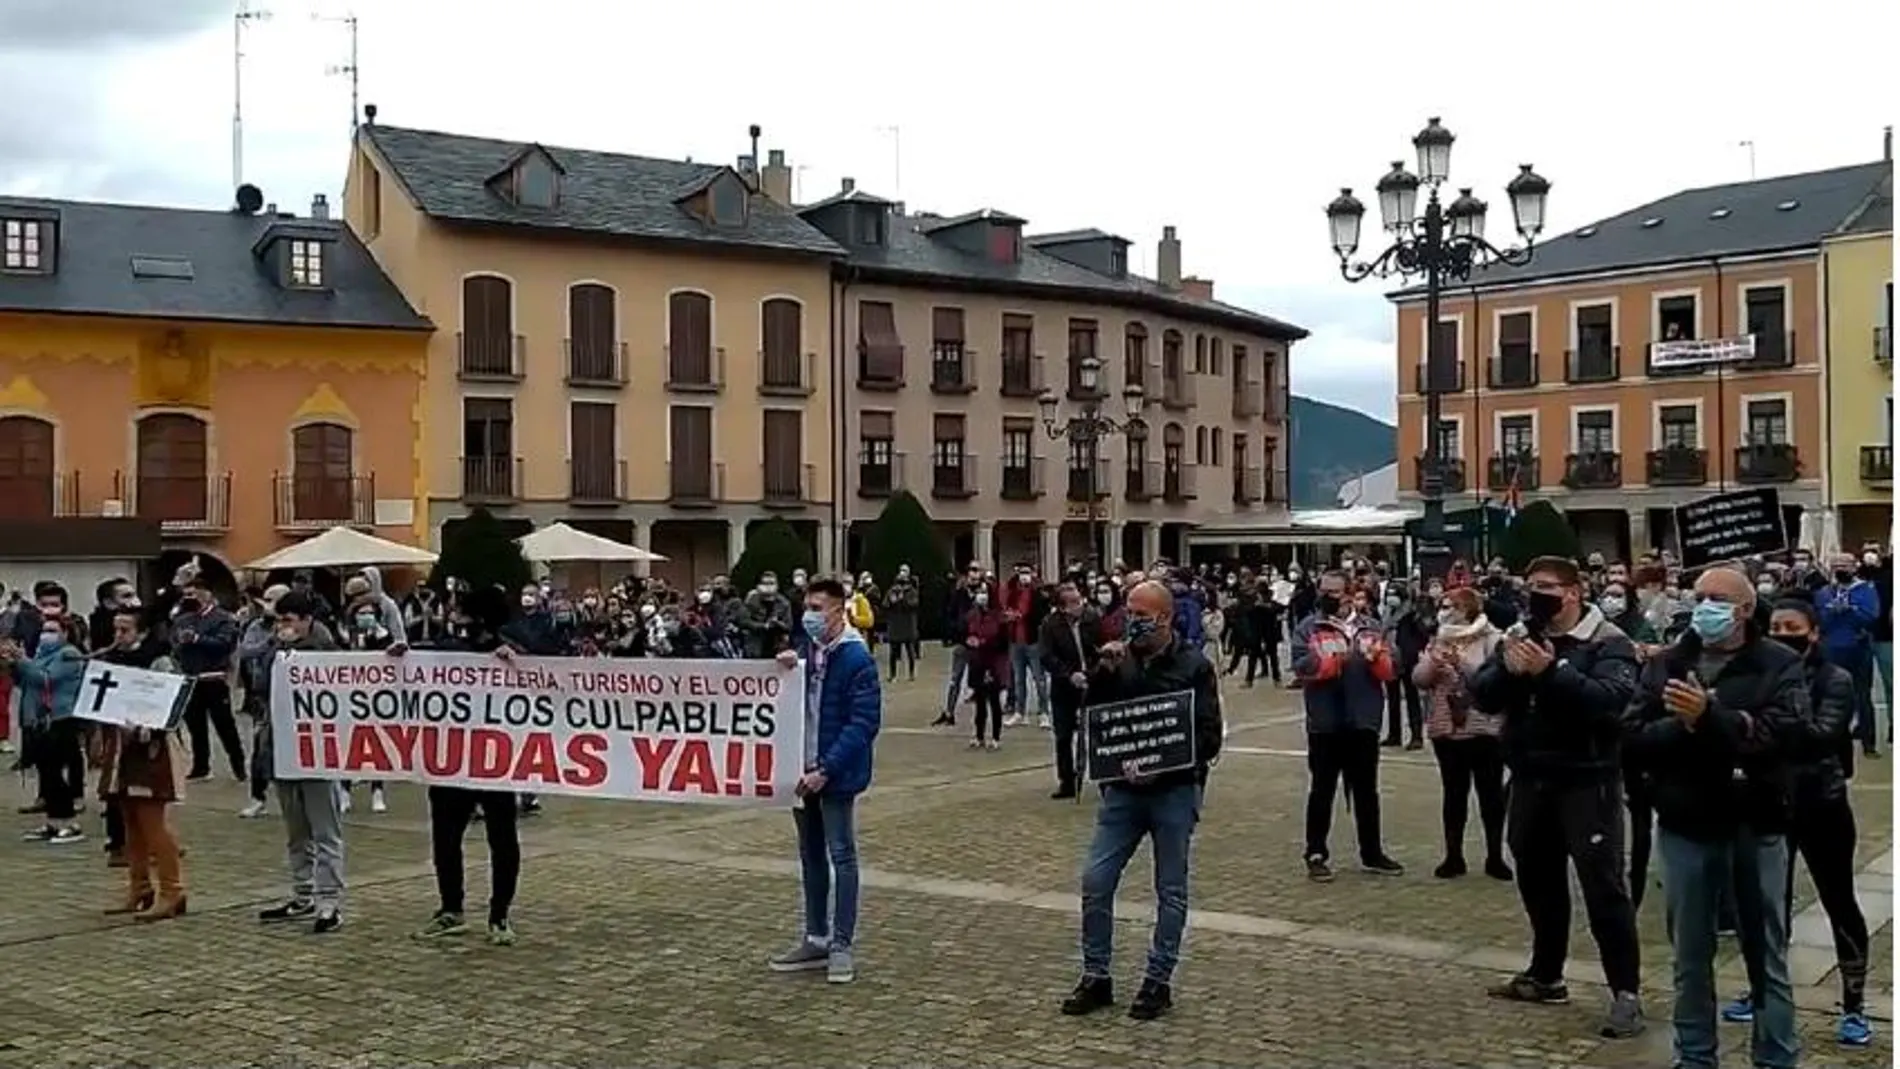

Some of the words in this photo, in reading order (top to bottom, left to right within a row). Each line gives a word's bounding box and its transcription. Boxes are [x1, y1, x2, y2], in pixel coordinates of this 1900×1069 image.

[289, 665, 397, 685] SALVEMOS
[402, 667, 426, 685] LA
[570, 671, 664, 695] TURISMO
[668, 676, 682, 695] Y
[690, 676, 718, 696] EL
[723, 676, 780, 698] OCIO
[292, 689, 339, 720] NO
[350, 689, 472, 724] SOMOS
[484, 693, 554, 727] LOS
[565, 698, 776, 738] CULPABLES
[297, 723, 608, 787] ¡¡AYUDAS
[632, 736, 774, 797] YA!!
